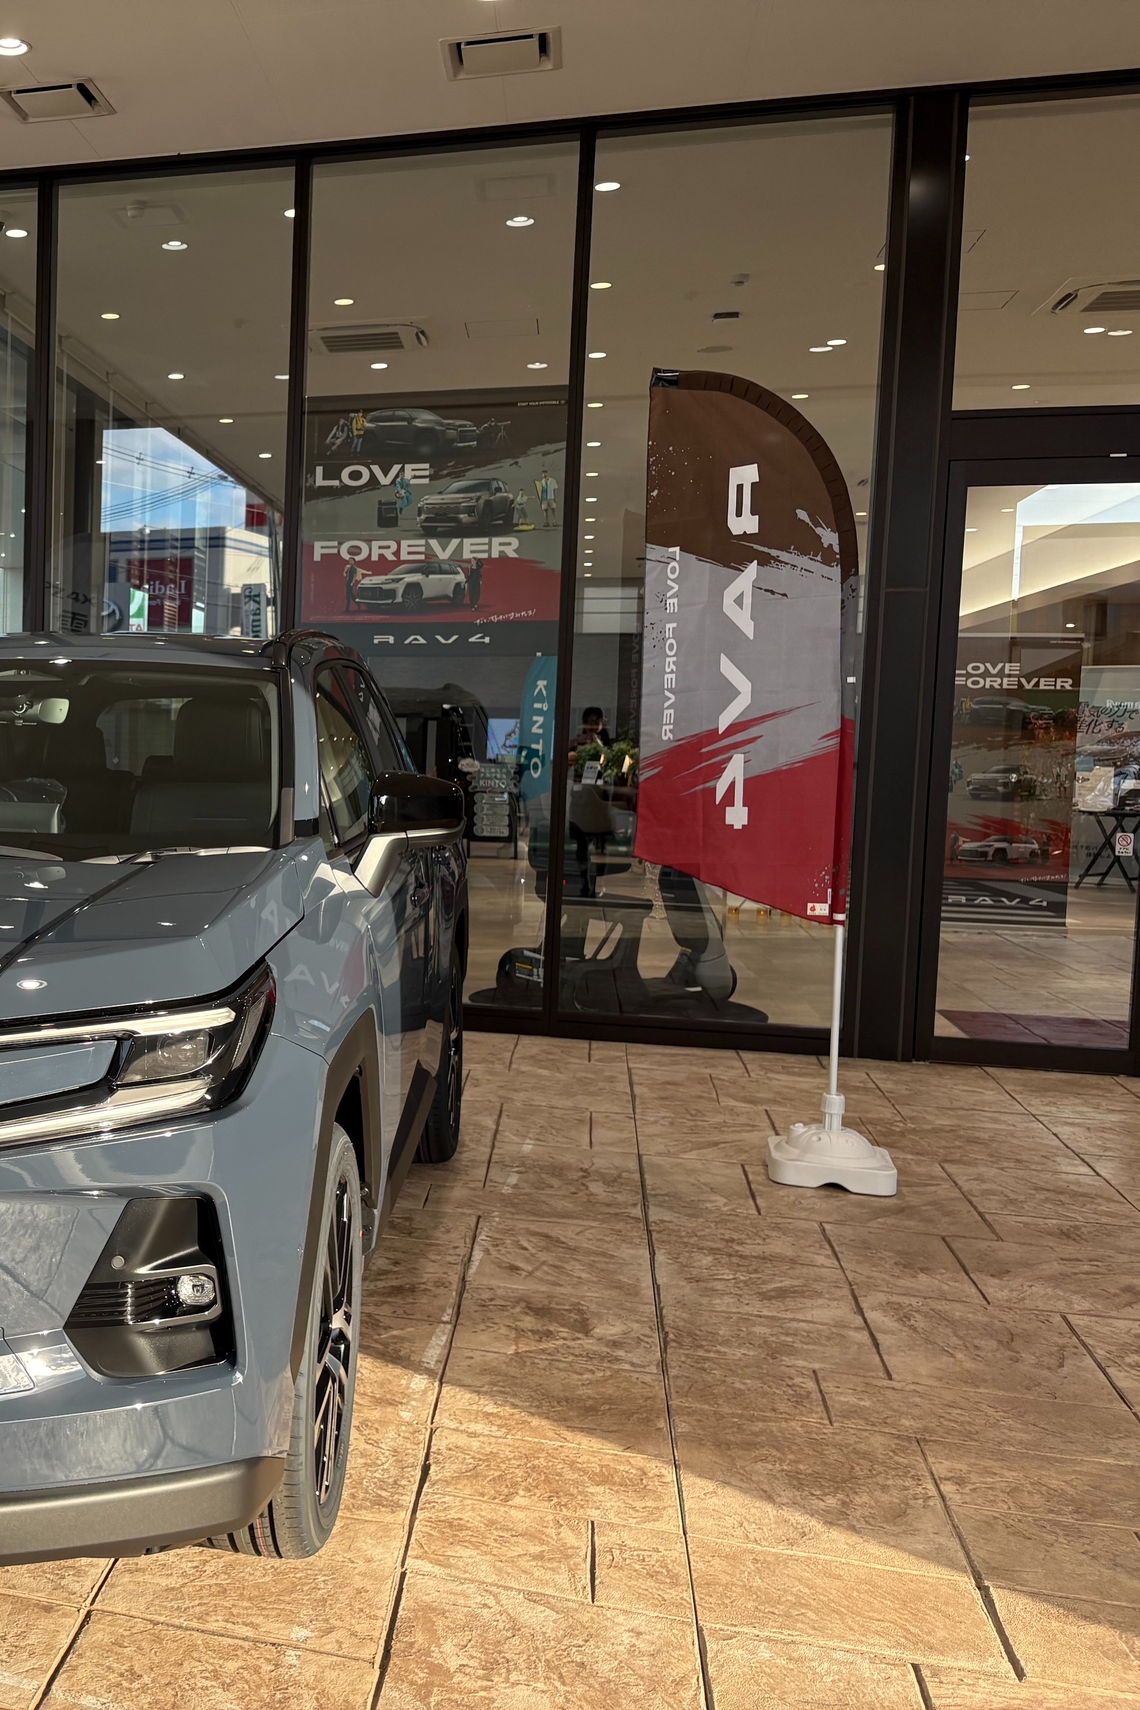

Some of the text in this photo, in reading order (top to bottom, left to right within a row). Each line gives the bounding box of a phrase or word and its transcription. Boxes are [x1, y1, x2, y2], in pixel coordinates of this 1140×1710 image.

[314, 463, 430, 487] LOVE
[313, 536, 519, 562] FOREVER
[373, 633, 491, 645] RAV4
[947, 895, 1048, 907] RAV4
